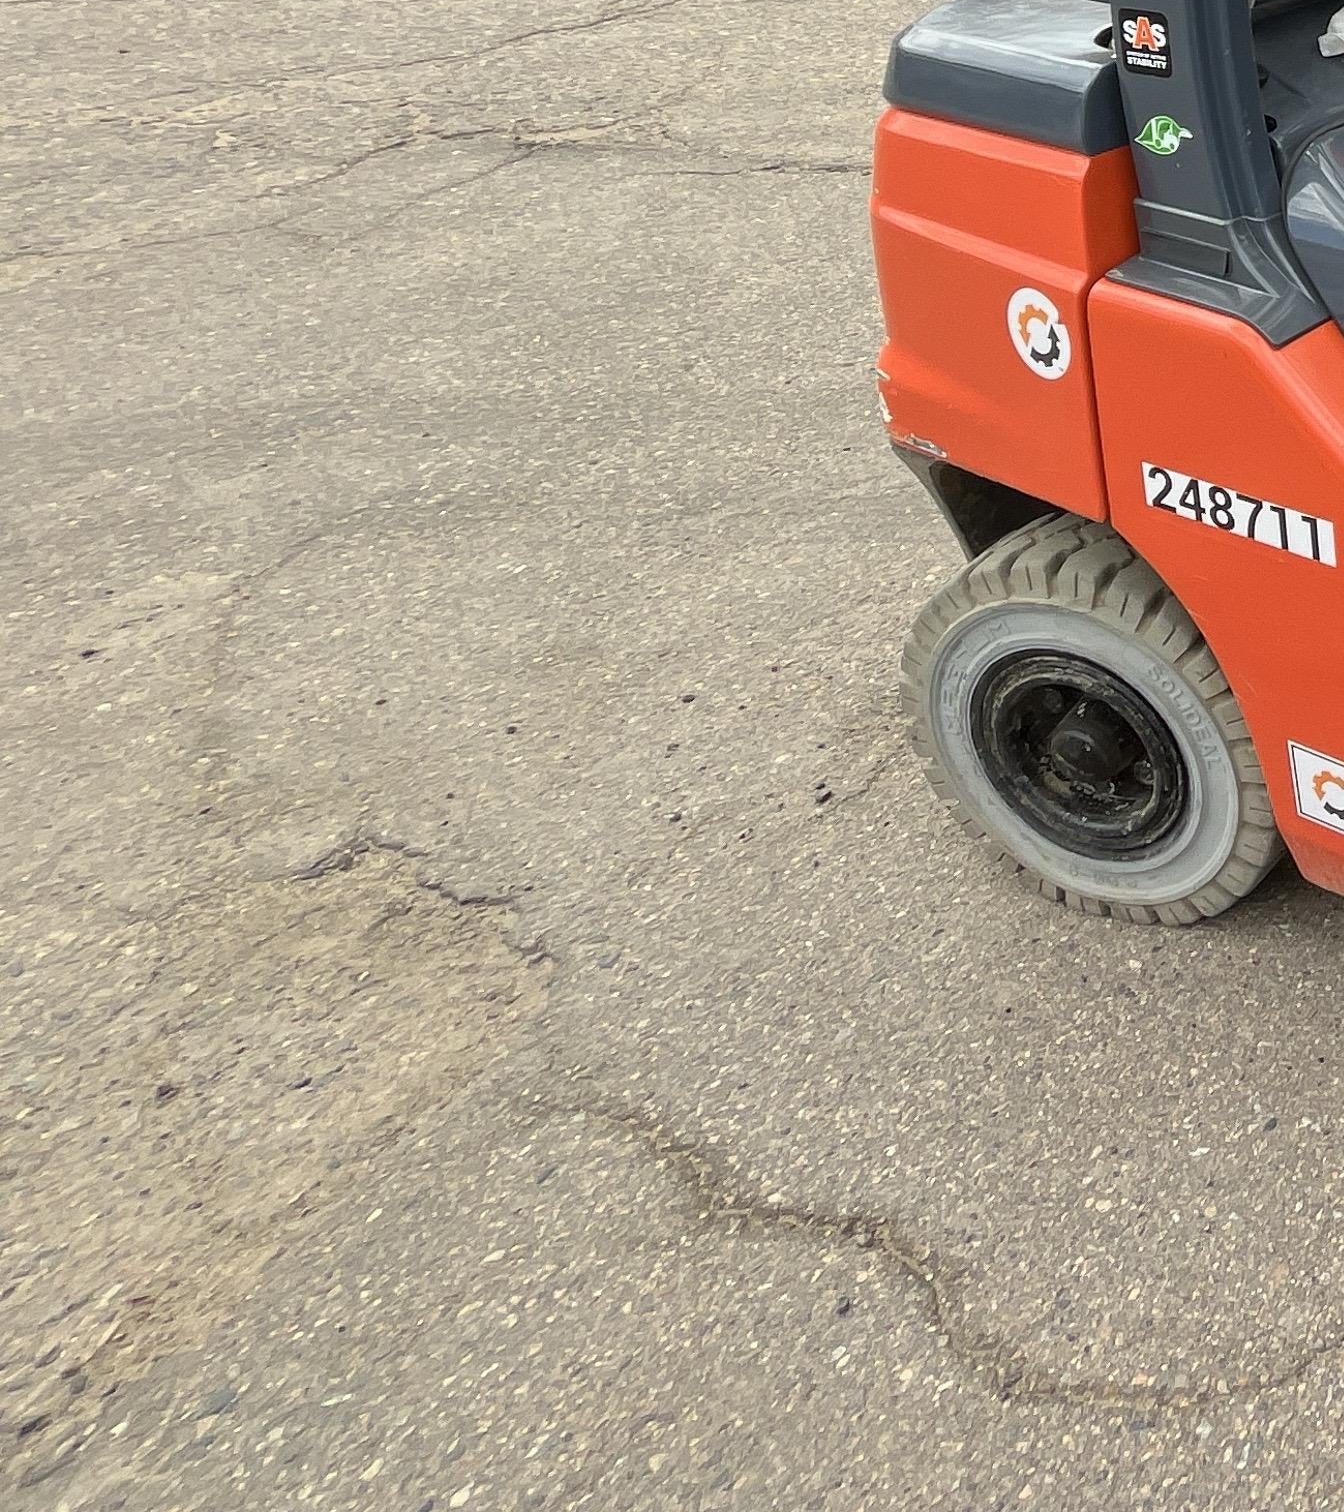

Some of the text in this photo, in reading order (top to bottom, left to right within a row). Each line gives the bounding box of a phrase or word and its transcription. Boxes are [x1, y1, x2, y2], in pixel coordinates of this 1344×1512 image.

[1122, 15, 1167, 52] SAS
[1127, 56, 1167, 69] STABILITY
[1148, 467, 1321, 562] 248711
